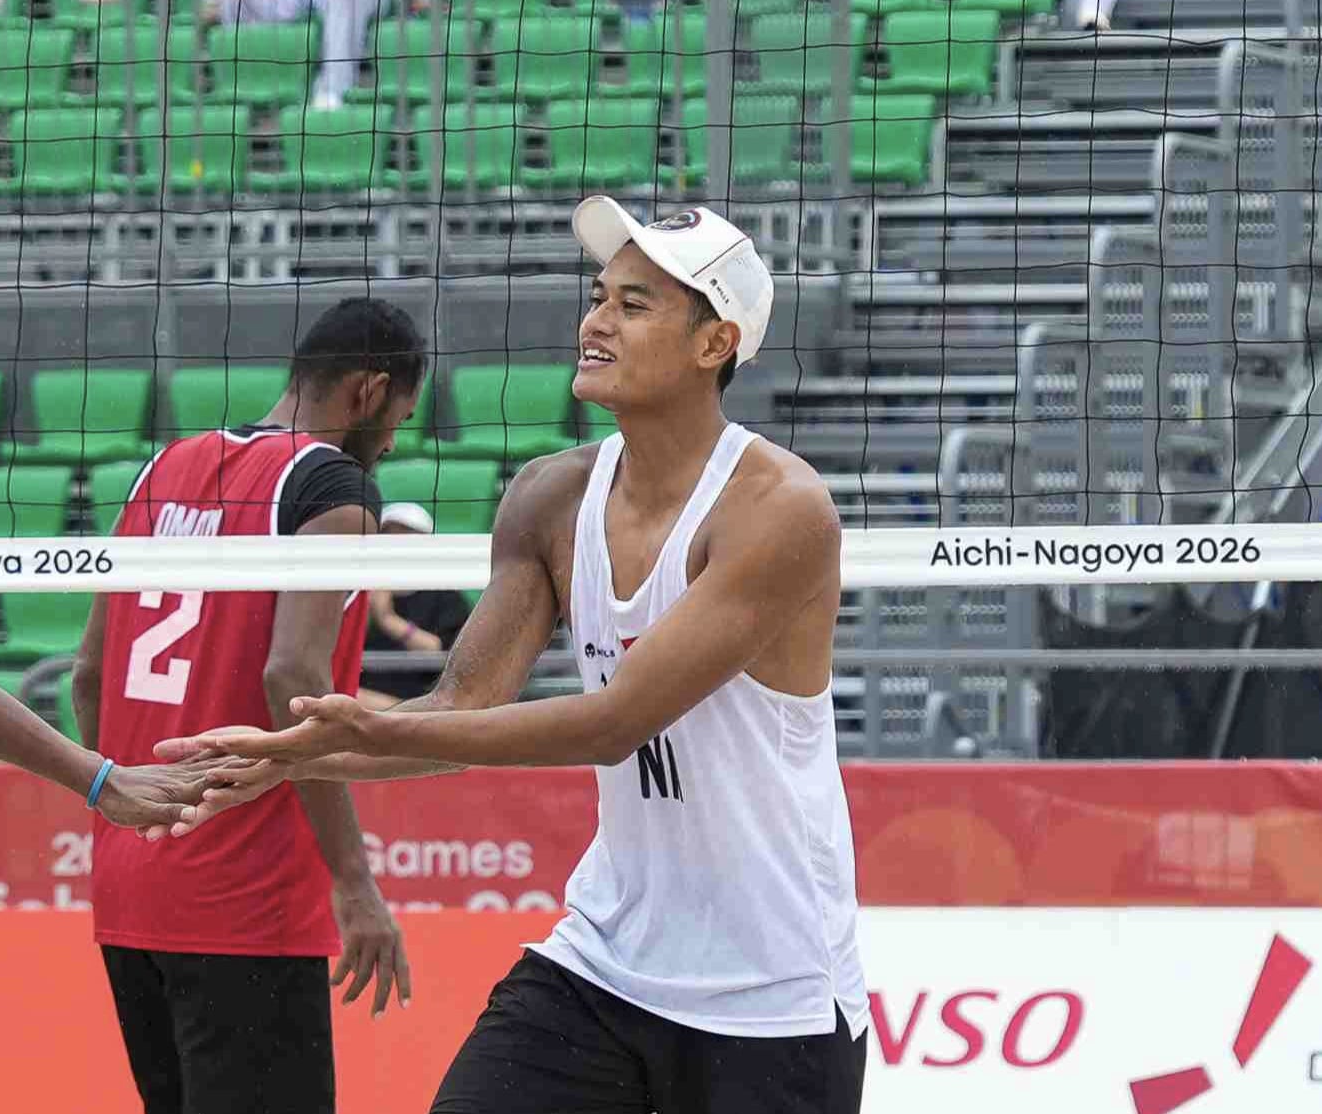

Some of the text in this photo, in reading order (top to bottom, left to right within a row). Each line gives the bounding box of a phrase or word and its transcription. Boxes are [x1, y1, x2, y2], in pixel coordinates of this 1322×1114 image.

[33, 549, 113, 574] 2026
[930, 537, 1261, 573] Aichi-Nagoya 2026
[124, 589, 205, 705] 2
[867, 990, 1085, 1068] NSO
